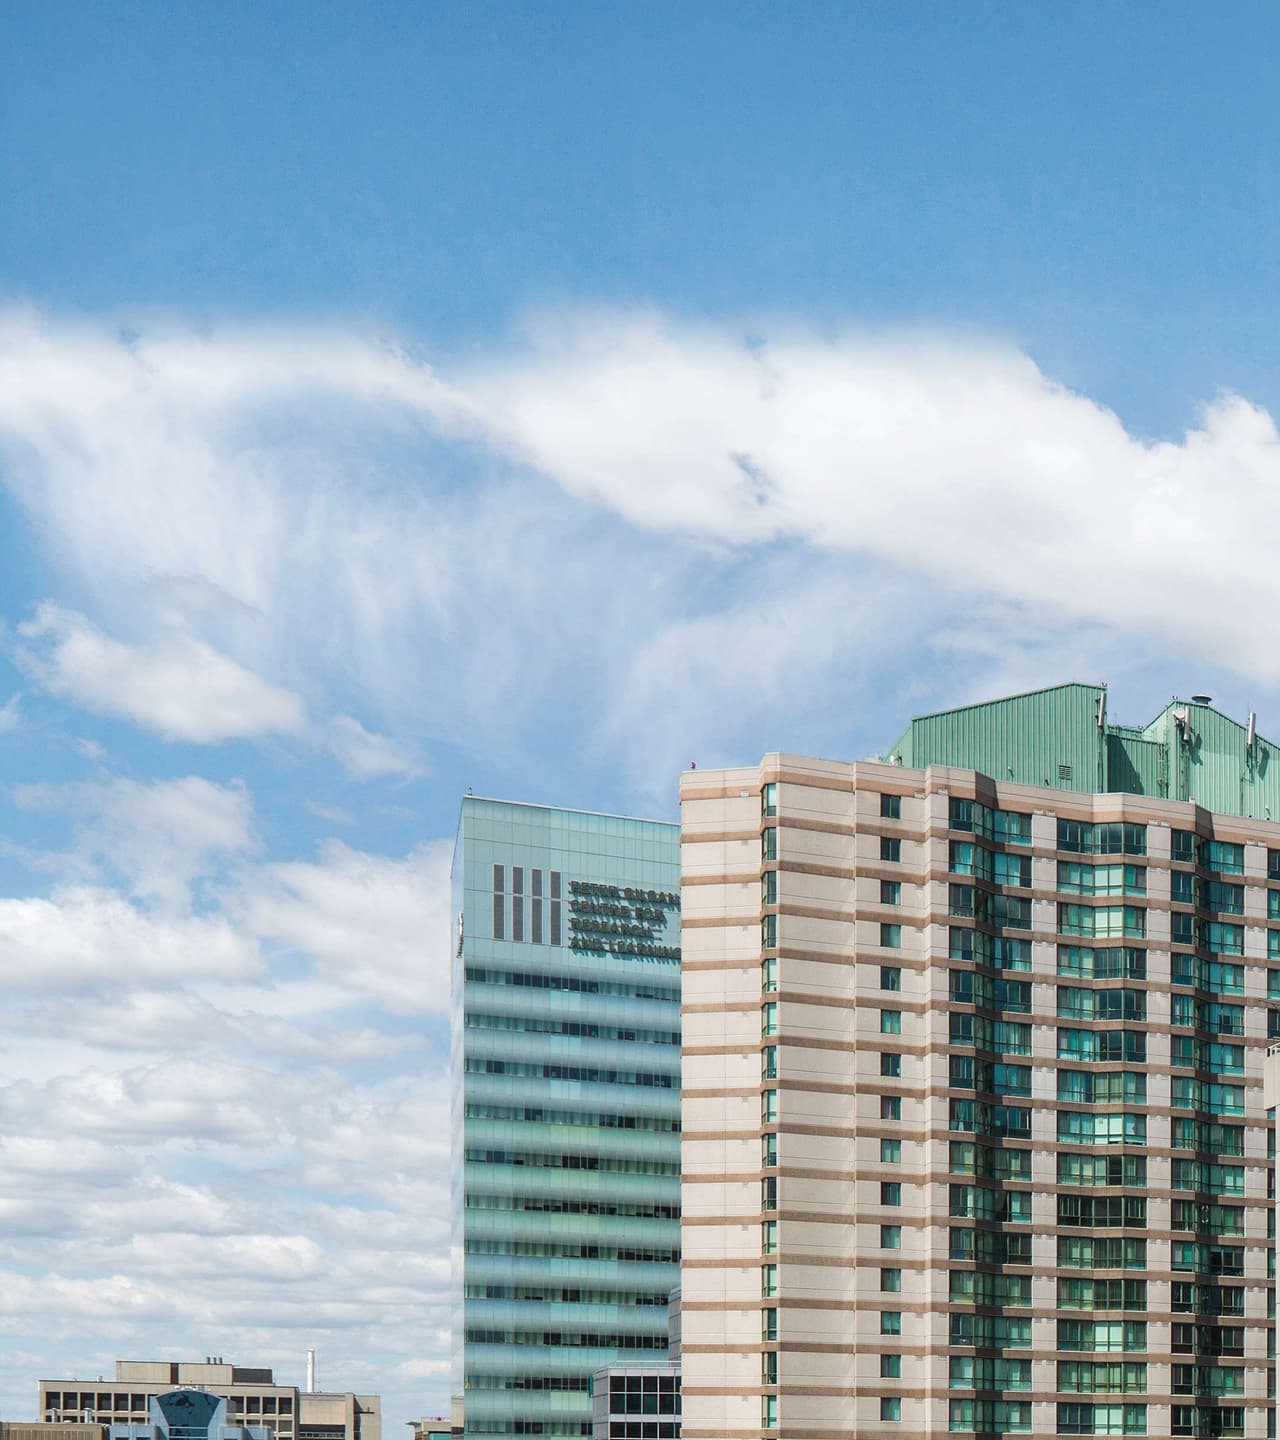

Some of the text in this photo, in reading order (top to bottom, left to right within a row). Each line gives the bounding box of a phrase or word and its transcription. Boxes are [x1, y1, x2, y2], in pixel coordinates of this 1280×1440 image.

[570, 900, 664, 921] CENTRE FOR
[570, 918, 653, 937] RESEARCH
[570, 936, 604, 952] AND
